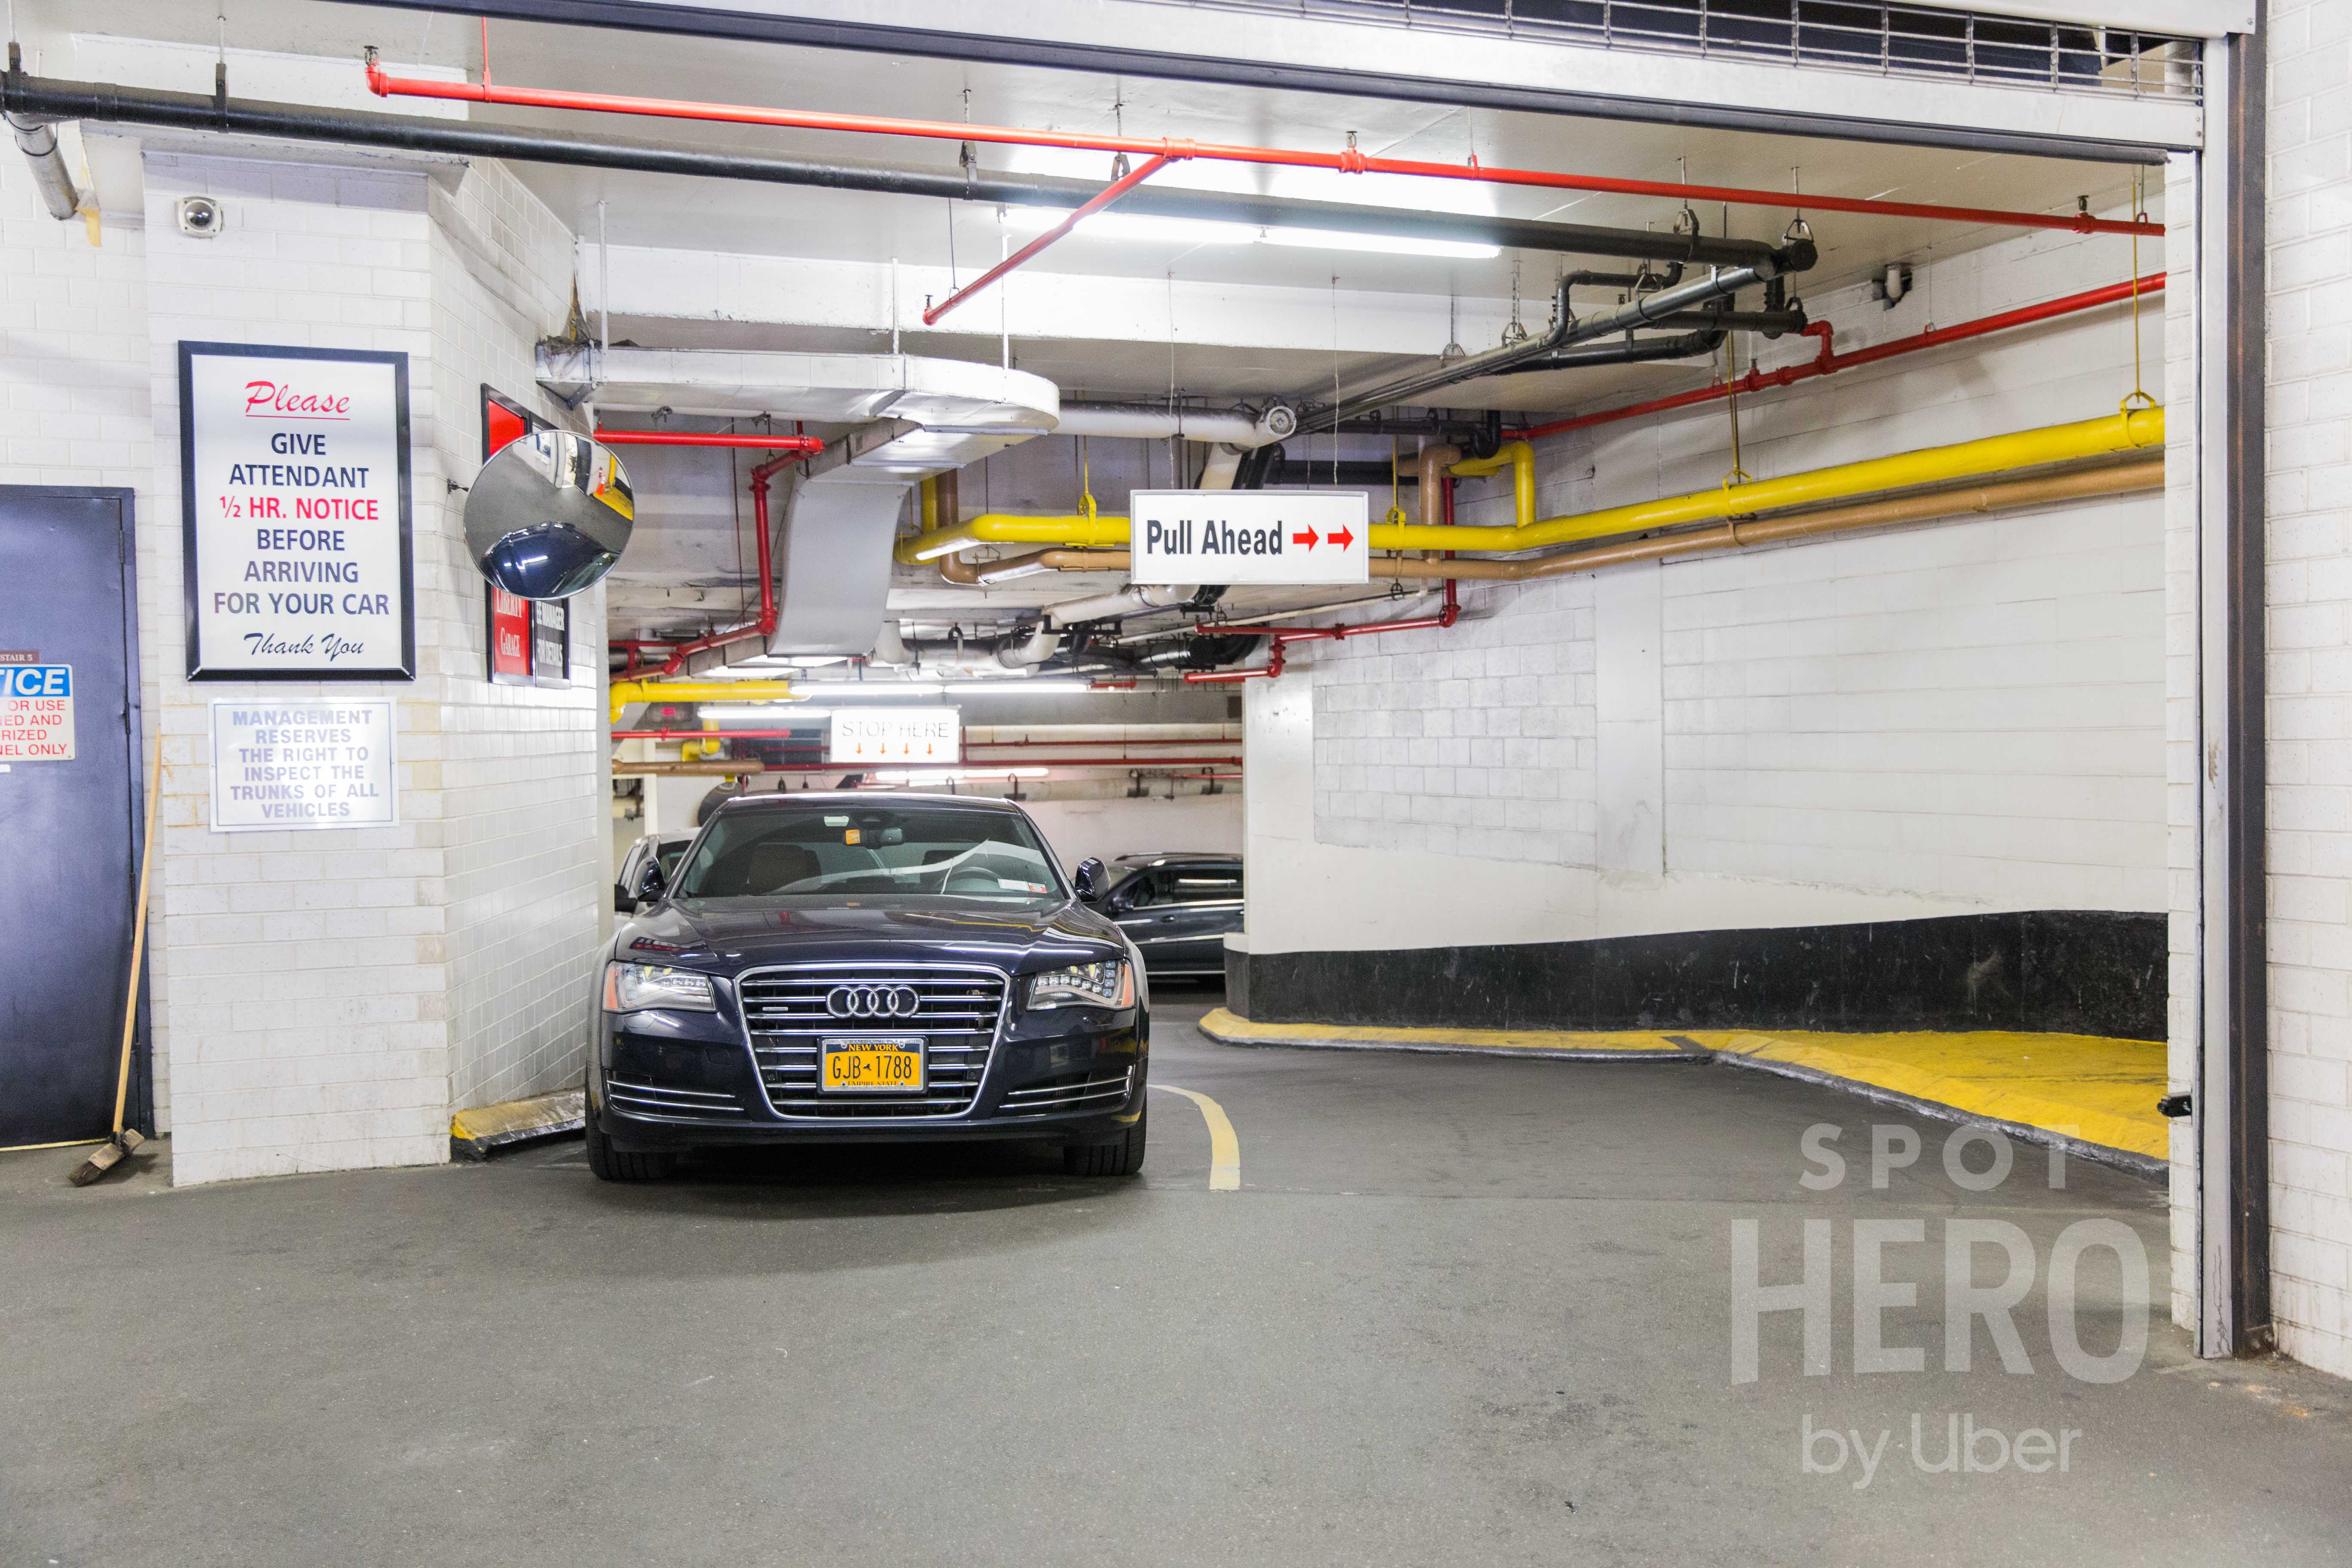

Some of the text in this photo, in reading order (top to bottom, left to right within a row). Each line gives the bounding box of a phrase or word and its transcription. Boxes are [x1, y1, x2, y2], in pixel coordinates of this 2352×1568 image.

[245, 381, 350, 413] Please
[271, 433, 326, 455] GIVE
[230, 464, 369, 488] ATTENDANT
[251, 498, 286, 518] HR.
[296, 498, 379, 520] NOTICE
[257, 529, 345, 551] BEFORE
[1147, 520, 1282, 555] Pull Ahead
[245, 561, 358, 583] ARRIVING
[214, 592, 389, 615] FOR YOUR CAR
[244, 633, 364, 662] Thank You
[501, 627, 521, 657] GARAGE
[0, 668, 66, 695] ICE
[36, 700, 66, 710] USE
[30, 715, 62, 725] AND
[233, 710, 372, 726] MANAGEMENT
[842, 721, 948, 737] STOP HERE
[256, 729, 351, 744] RESERVES
[28, 744, 67, 755] ONLY
[239, 747, 368, 763] THE RIGHT TO
[245, 765, 364, 781] INSPECT THE
[230, 783, 378, 800] TRUNKS OF ALL
[261, 802, 350, 818] VEHICLES
